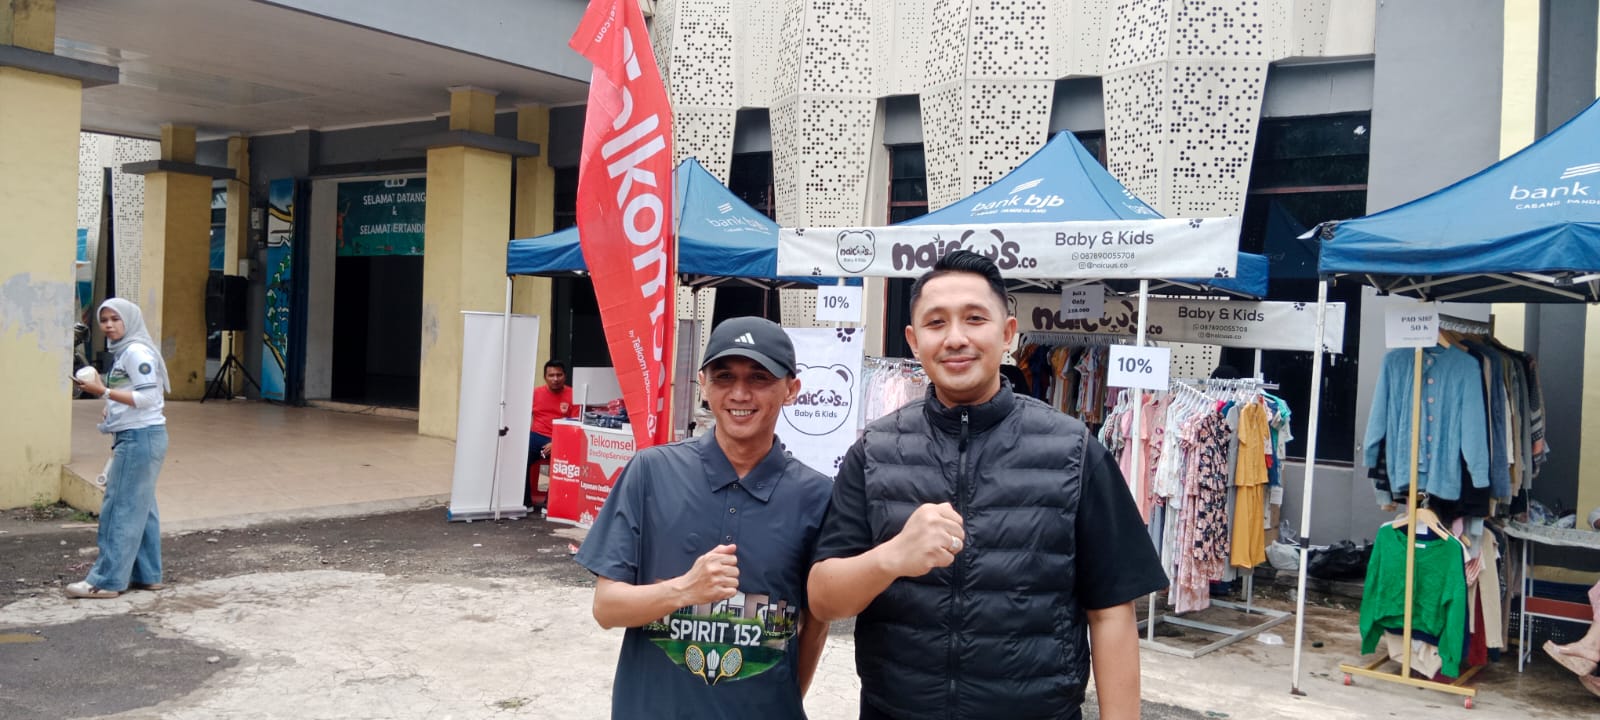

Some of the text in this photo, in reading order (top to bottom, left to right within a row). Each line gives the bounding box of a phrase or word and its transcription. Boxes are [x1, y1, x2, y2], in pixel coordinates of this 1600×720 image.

[363, 192, 426, 205] SELAMAT DATANG
[1510, 181, 1590, 200] bank
[971, 194, 1065, 211] bank bjb
[360, 224, 391, 235] SELAMAT
[1055, 230, 1154, 249] Baby & Kids
[823, 295, 850, 309] 10%
[1178, 306, 1265, 322] Baby & Kids
[632, 336, 648, 371] Telkom
[1117, 356, 1153, 374] 10%
[794, 409, 813, 419] Baby
[815, 410, 820, 418] &
[590, 434, 634, 452] Telkomsel
[552, 463, 580, 478] siaga
[670, 618, 762, 647] SPIRIT 152
